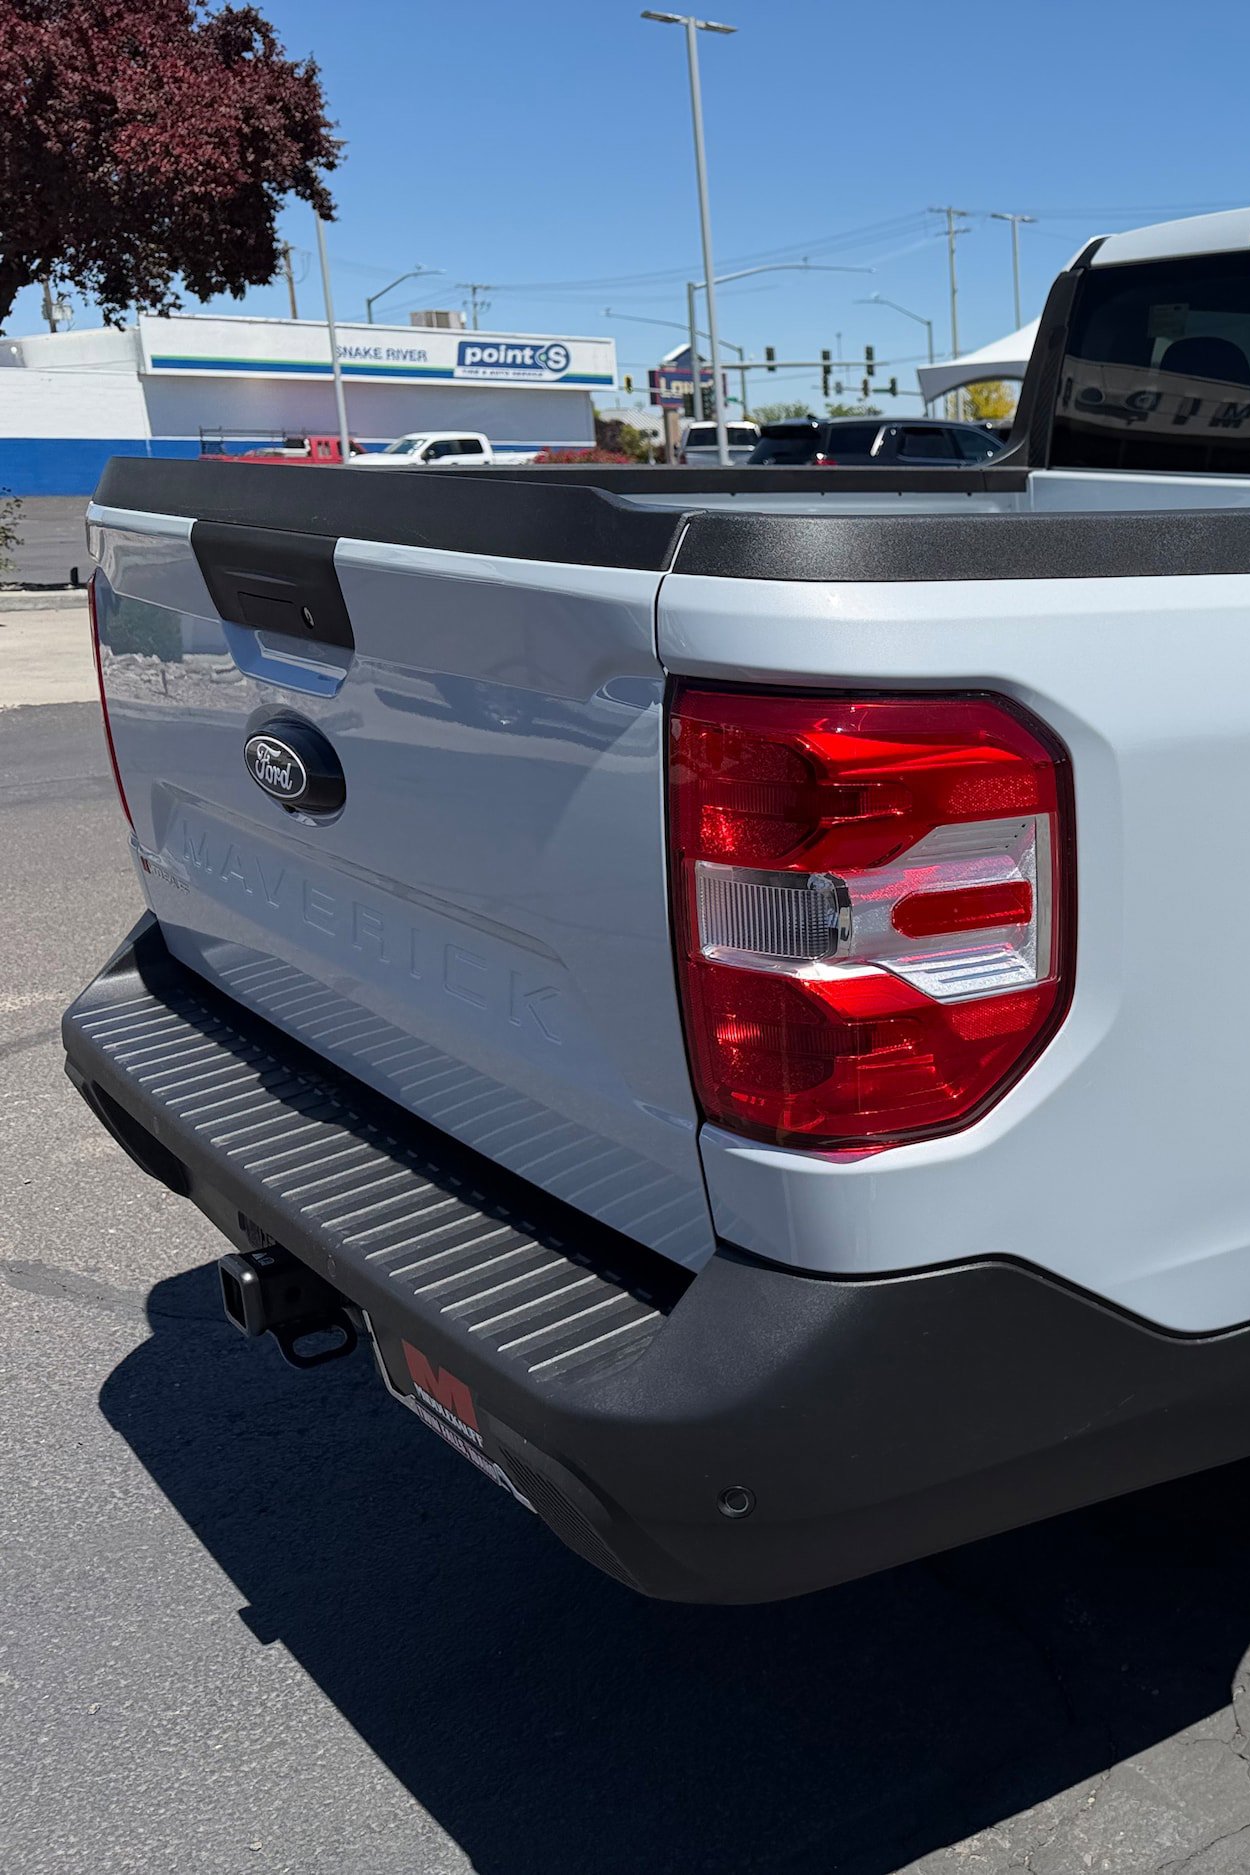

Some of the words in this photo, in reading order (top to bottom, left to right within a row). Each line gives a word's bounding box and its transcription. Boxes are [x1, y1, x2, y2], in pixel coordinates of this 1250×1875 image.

[337, 345, 383, 360] SNAKE
[386, 347, 428, 362] RIVER
[464, 345, 534, 366] point
[255, 742, 293, 791] Ford
[182, 819, 562, 1046] MAVERICK
